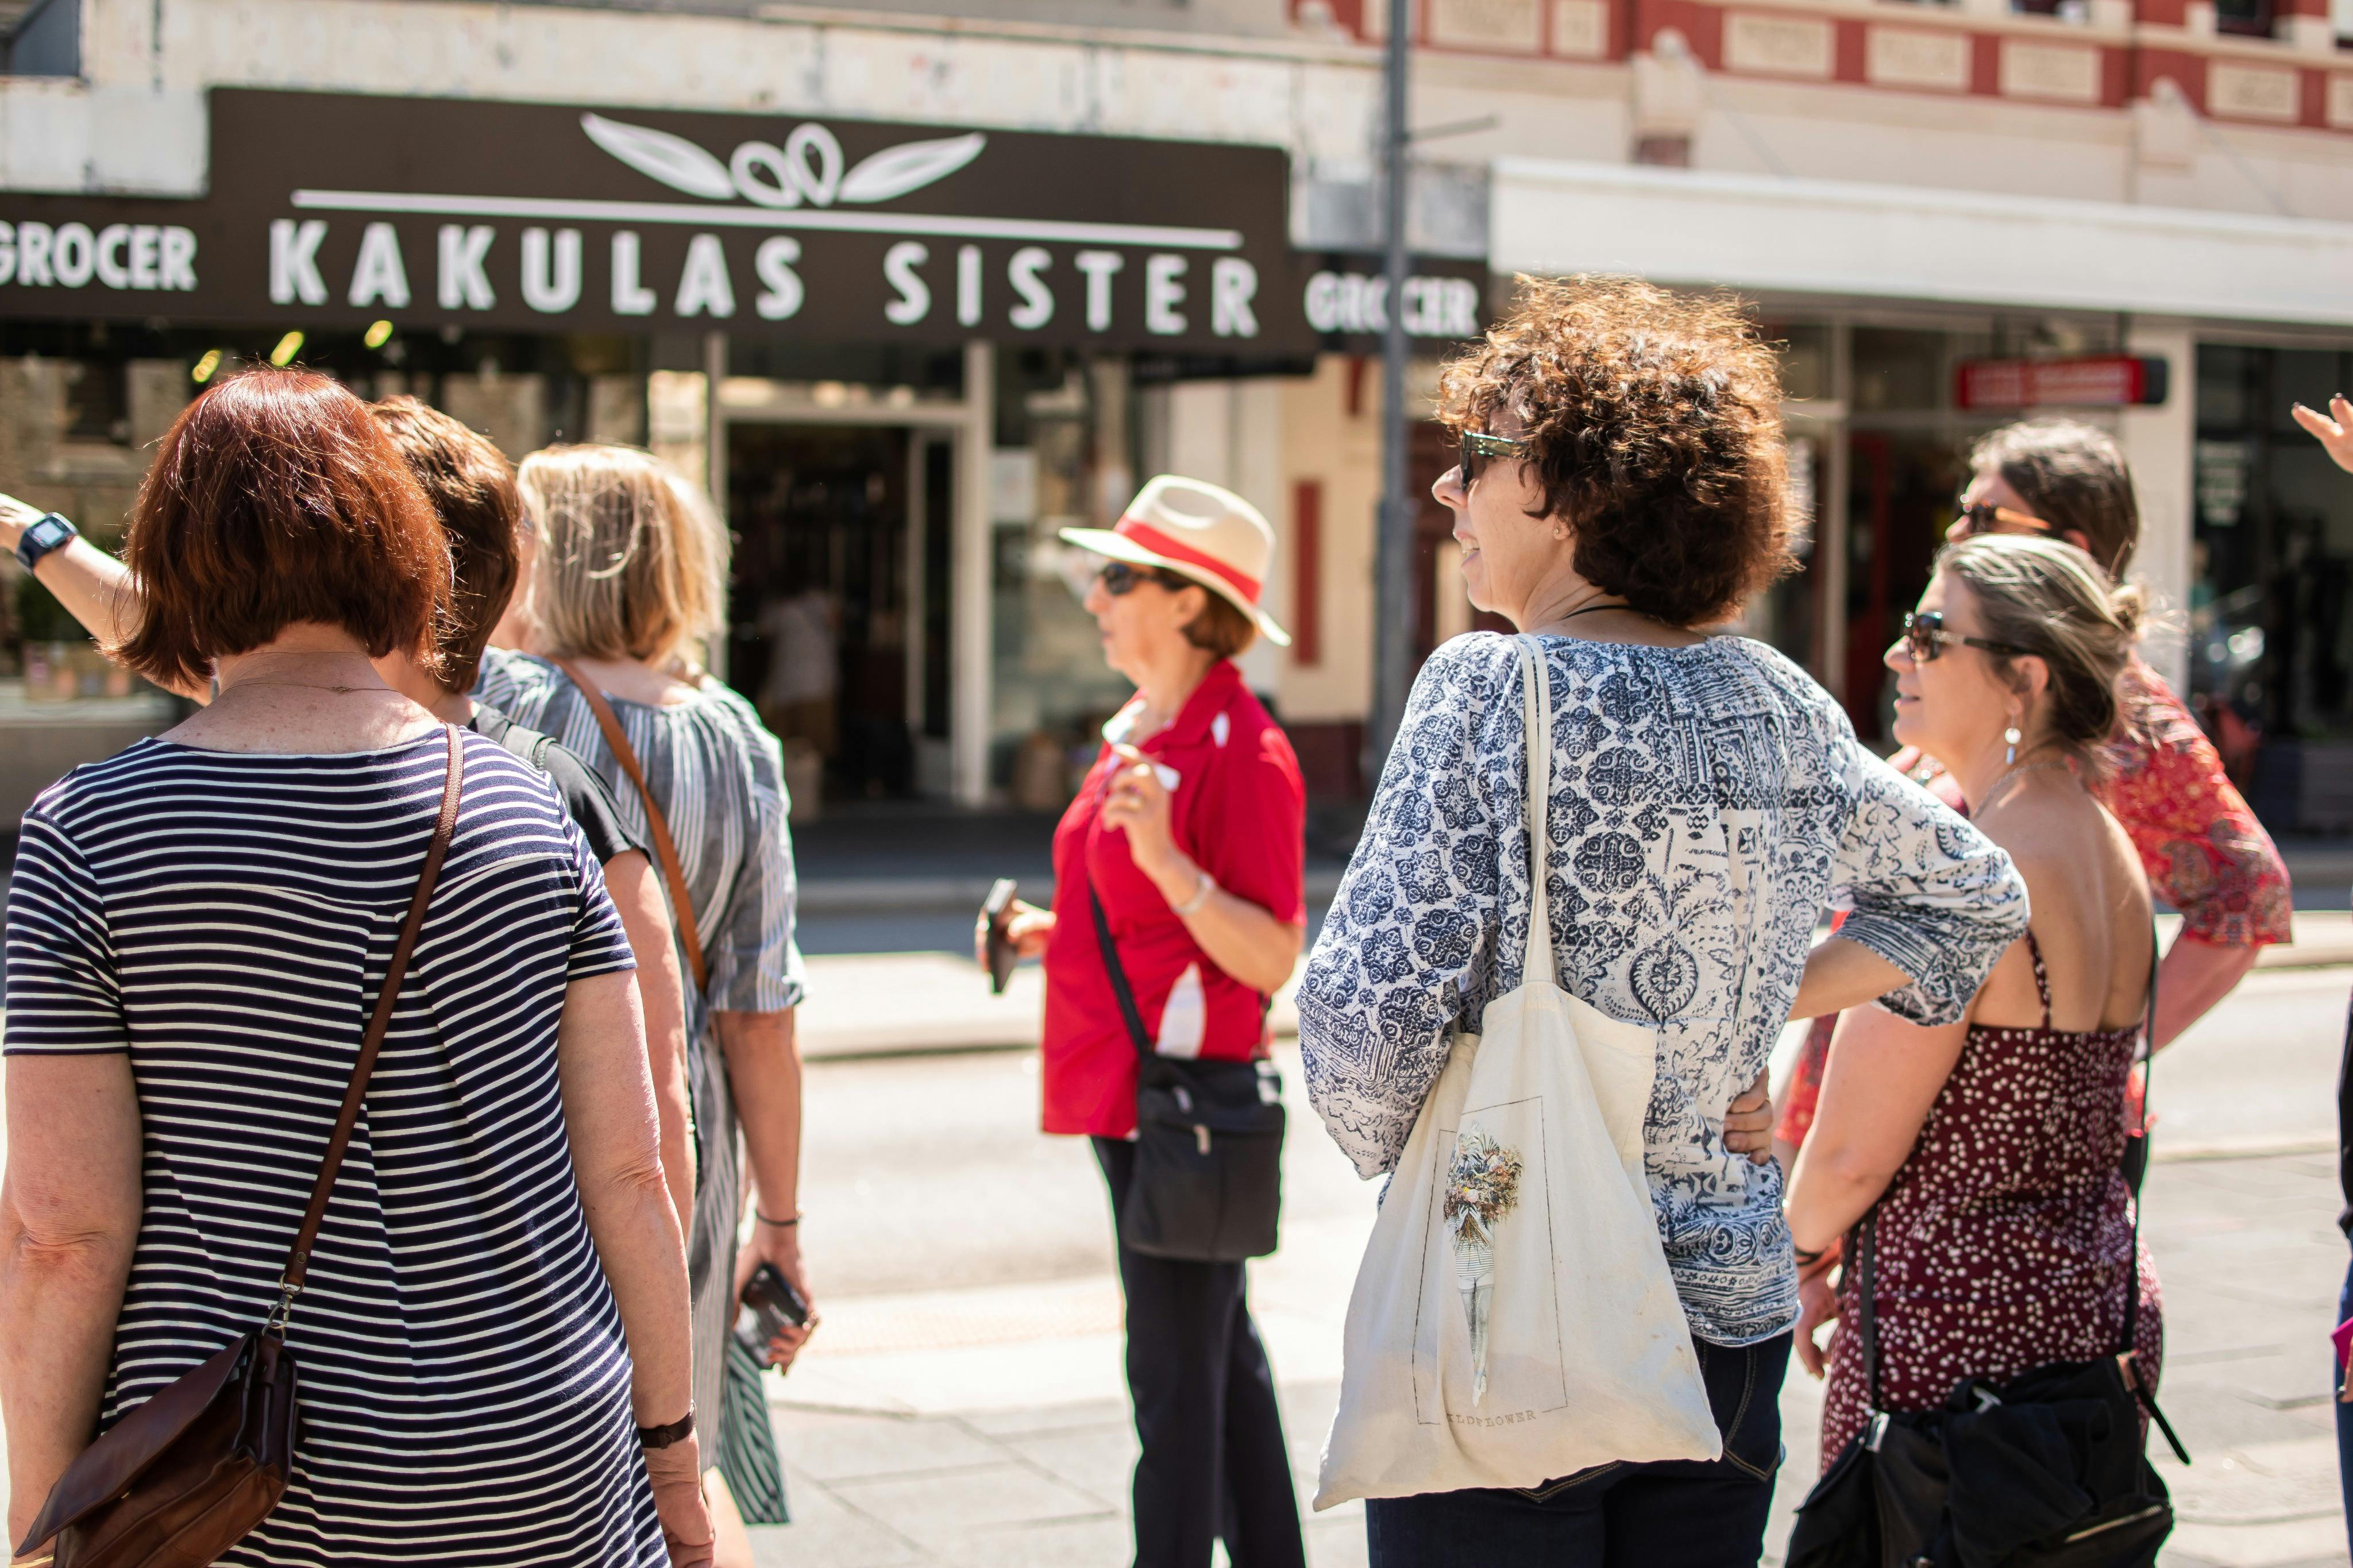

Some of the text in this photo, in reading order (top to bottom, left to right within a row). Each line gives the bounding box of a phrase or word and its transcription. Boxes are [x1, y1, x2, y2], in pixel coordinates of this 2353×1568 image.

[269, 218, 1257, 337] KAKULAS SISTER
[1446, 1410, 1536, 1427] ILDFLOWER
